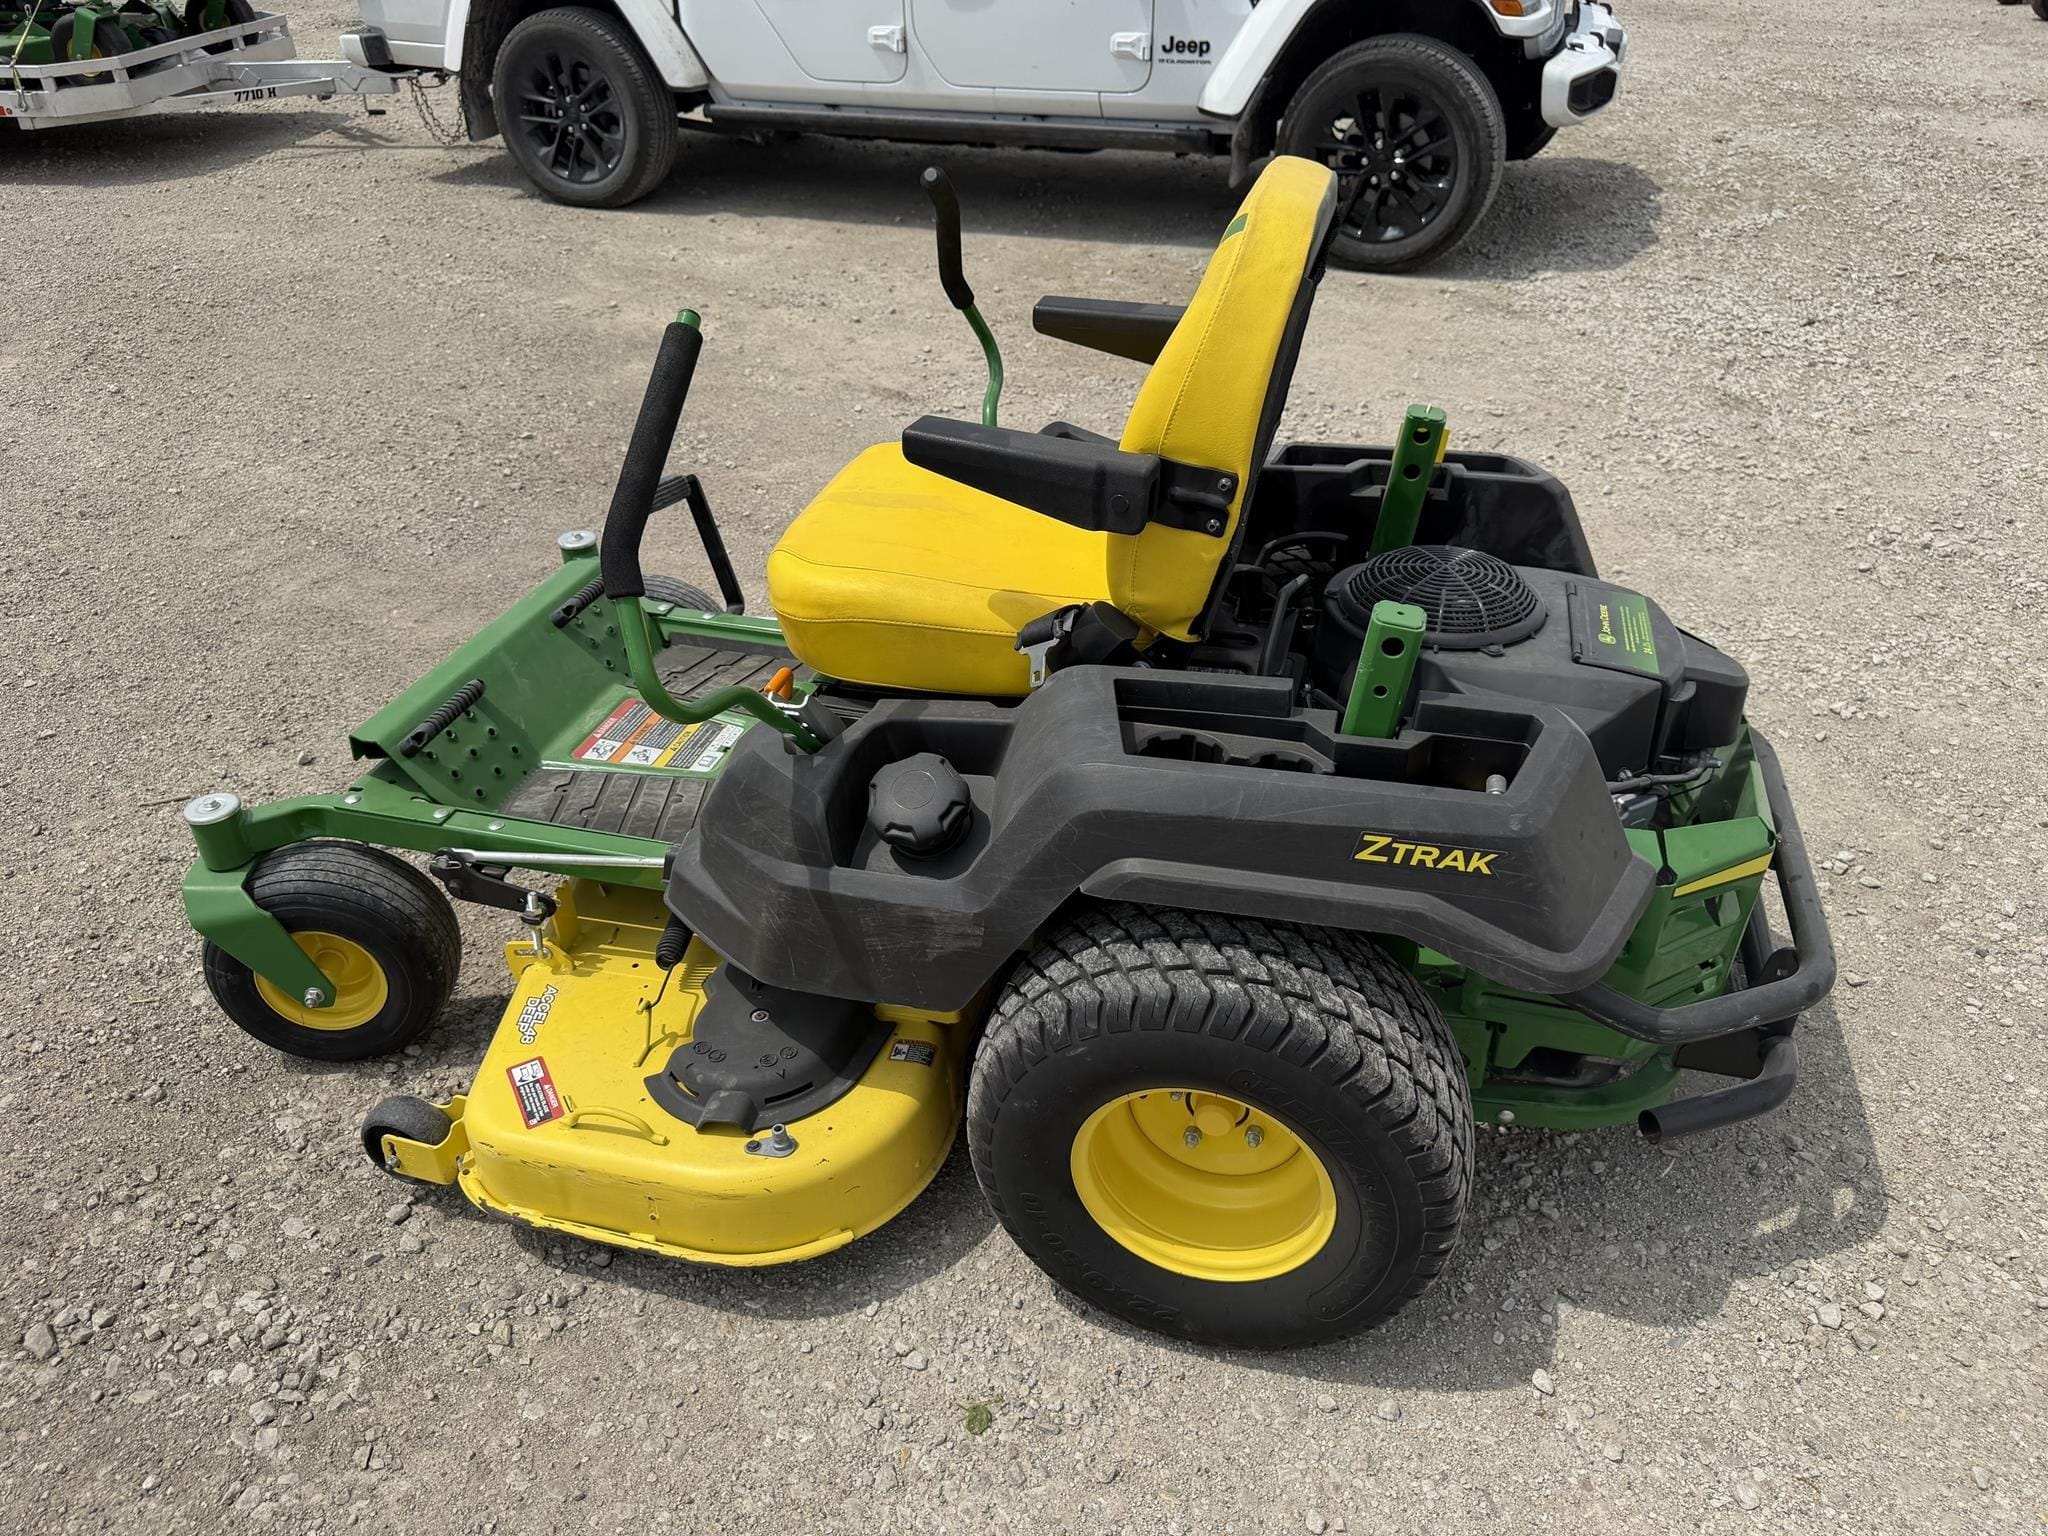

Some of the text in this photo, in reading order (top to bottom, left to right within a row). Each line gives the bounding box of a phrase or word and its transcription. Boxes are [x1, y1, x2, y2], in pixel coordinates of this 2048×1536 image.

[1161, 35, 1211, 58] Jeep
[233, 86, 277, 102] 7710 H
[1354, 834, 1499, 875] ZTRAK
[517, 997, 541, 1032] DEEP
[529, 984, 558, 1028] ACCEL
[546, 1087, 559, 1108] DANGER
